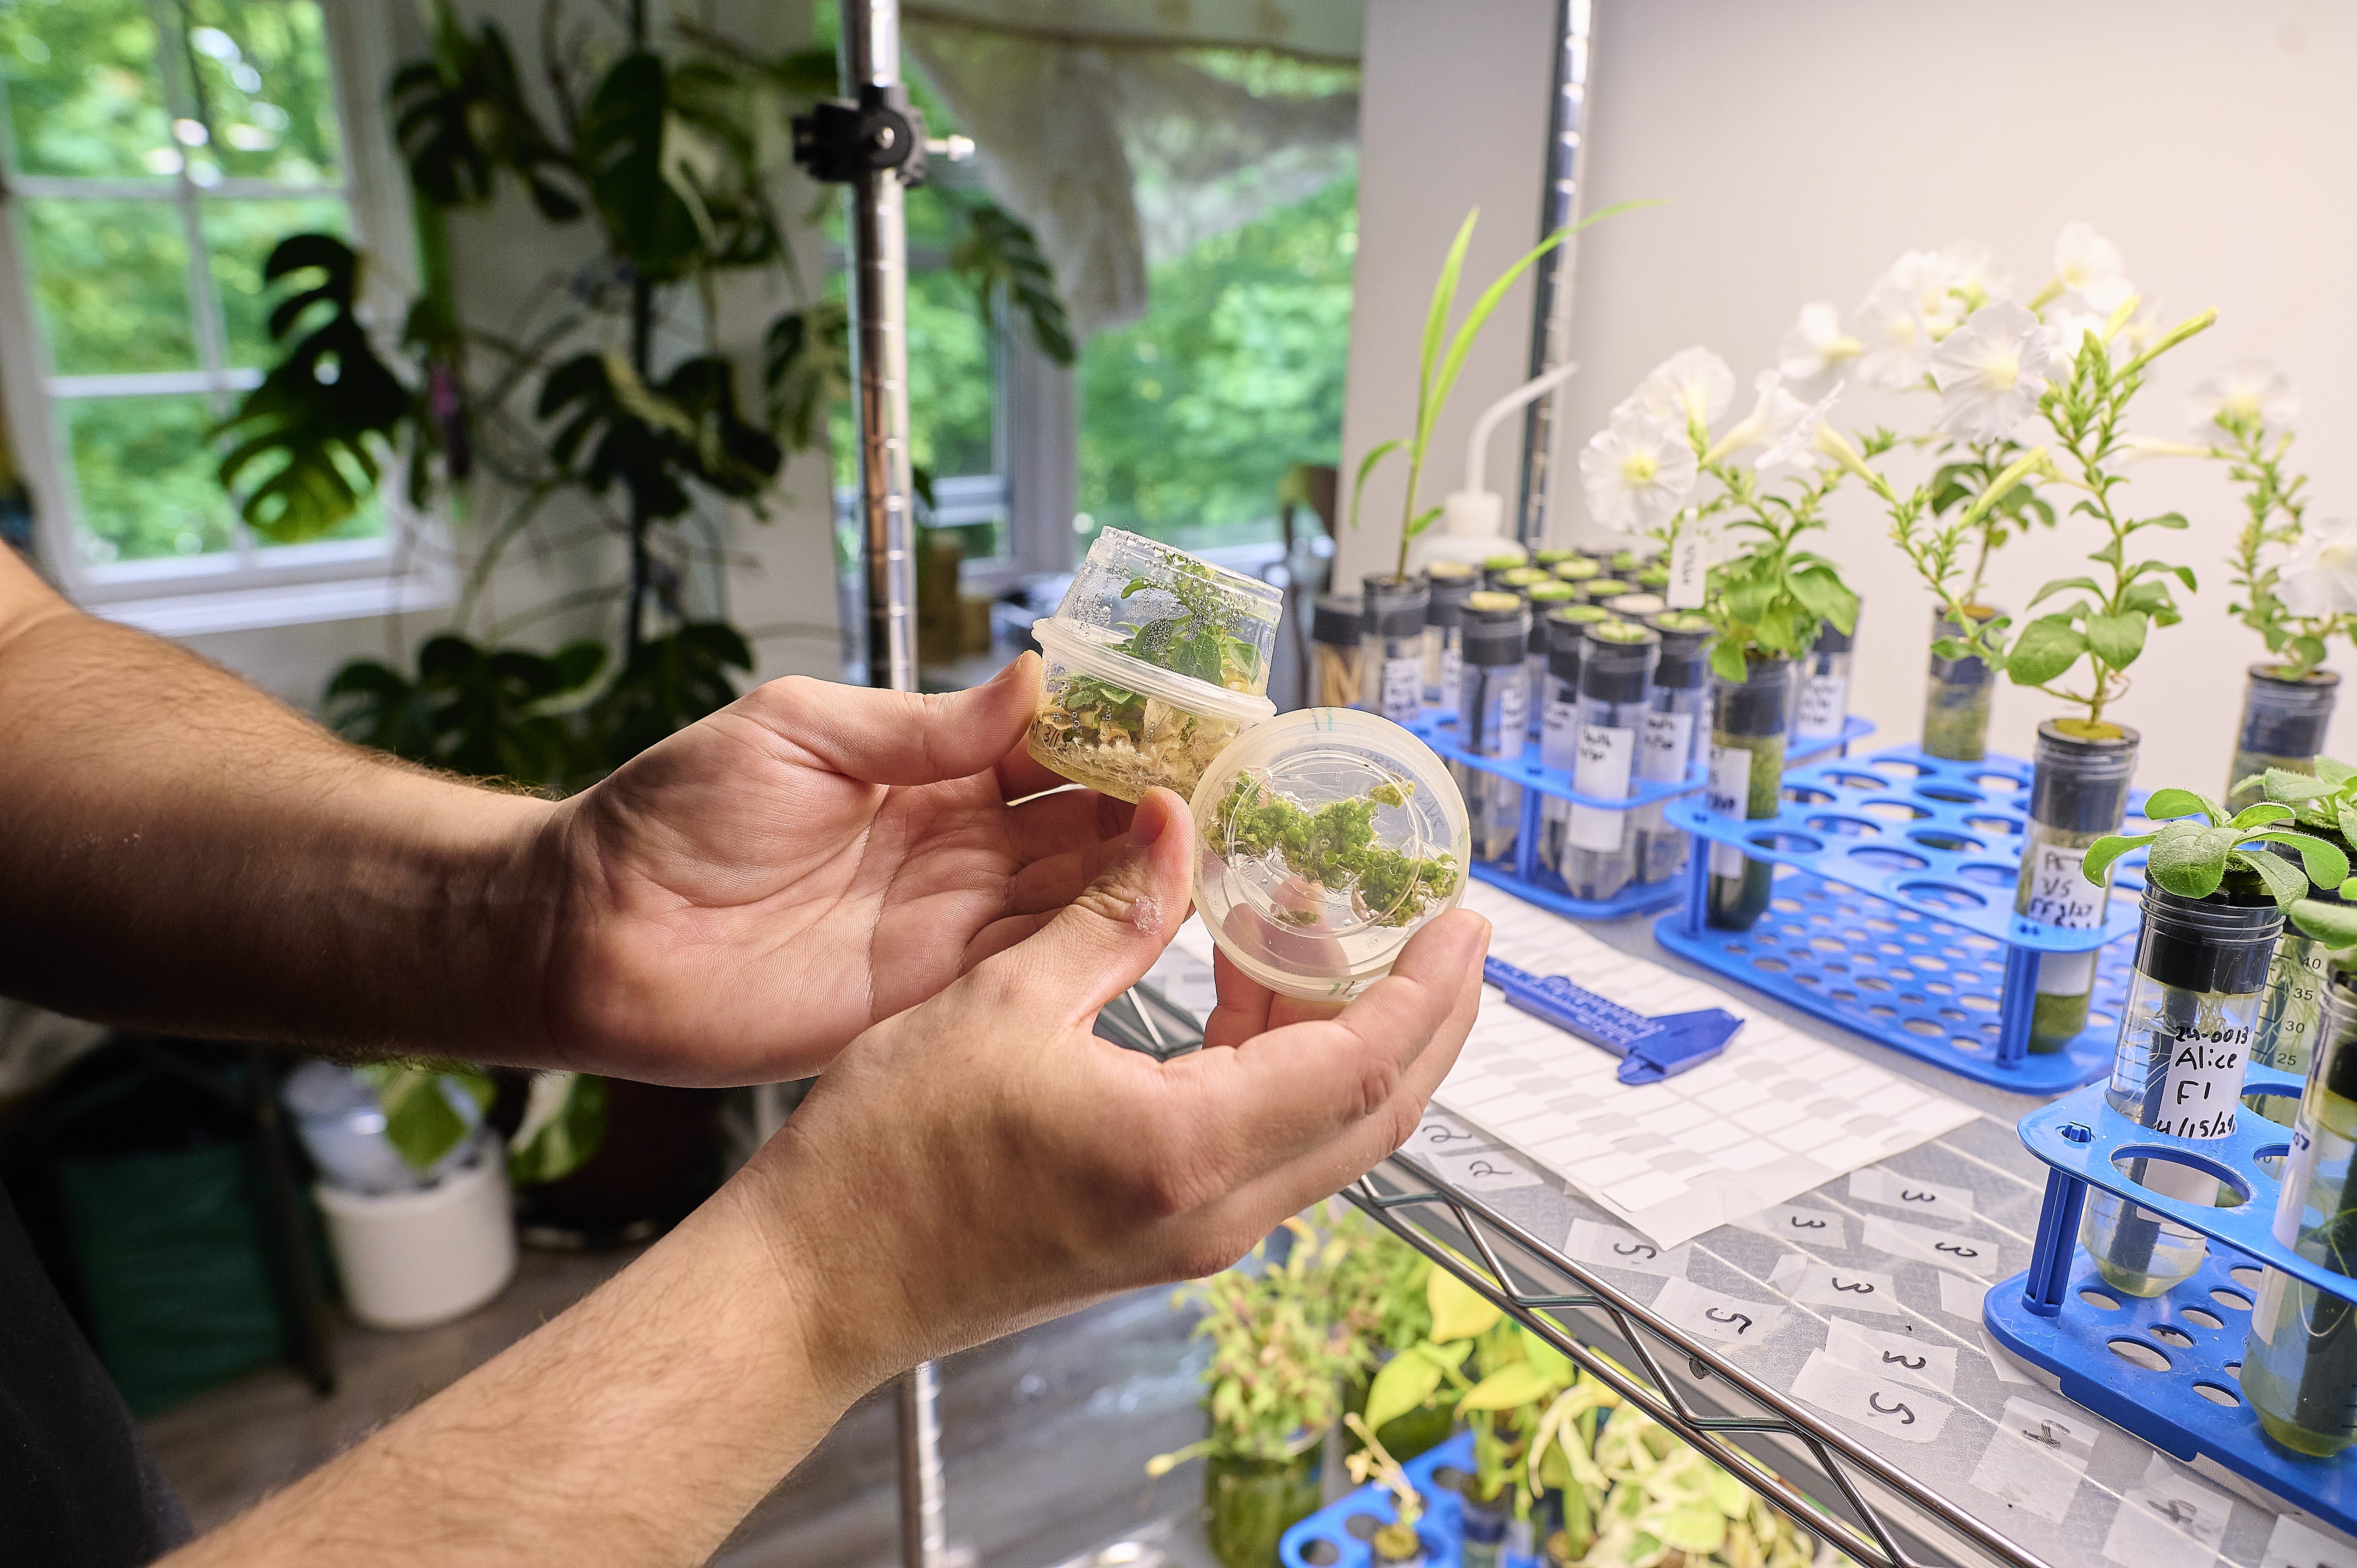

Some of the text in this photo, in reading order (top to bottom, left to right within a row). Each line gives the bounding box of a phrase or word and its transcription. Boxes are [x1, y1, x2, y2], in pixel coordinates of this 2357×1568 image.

[2301, 957, 2321, 969] 40
[2293, 988, 2313, 1001] 35
[2175, 1026, 2249, 1045] 24-0013
[2285, 1021, 2305, 1033] 30
[2175, 1045, 2237, 1070] Alice
[2277, 1053, 2297, 1066] 25
[1422, 1125, 1472, 1143] 2
[1469, 1160, 1512, 1178] 2
[1901, 1189, 1936, 1202] 3
[1792, 1215, 1826, 1228] 3
[1613, 1241, 1657, 1259] 5
[1935, 1242, 1978, 1258] 3
[1832, 1276, 1875, 1294] 3
[1705, 1307, 1753, 1335] 5
[1882, 1350, 1926, 1369] 3
[1869, 1391, 1915, 1425] 5
